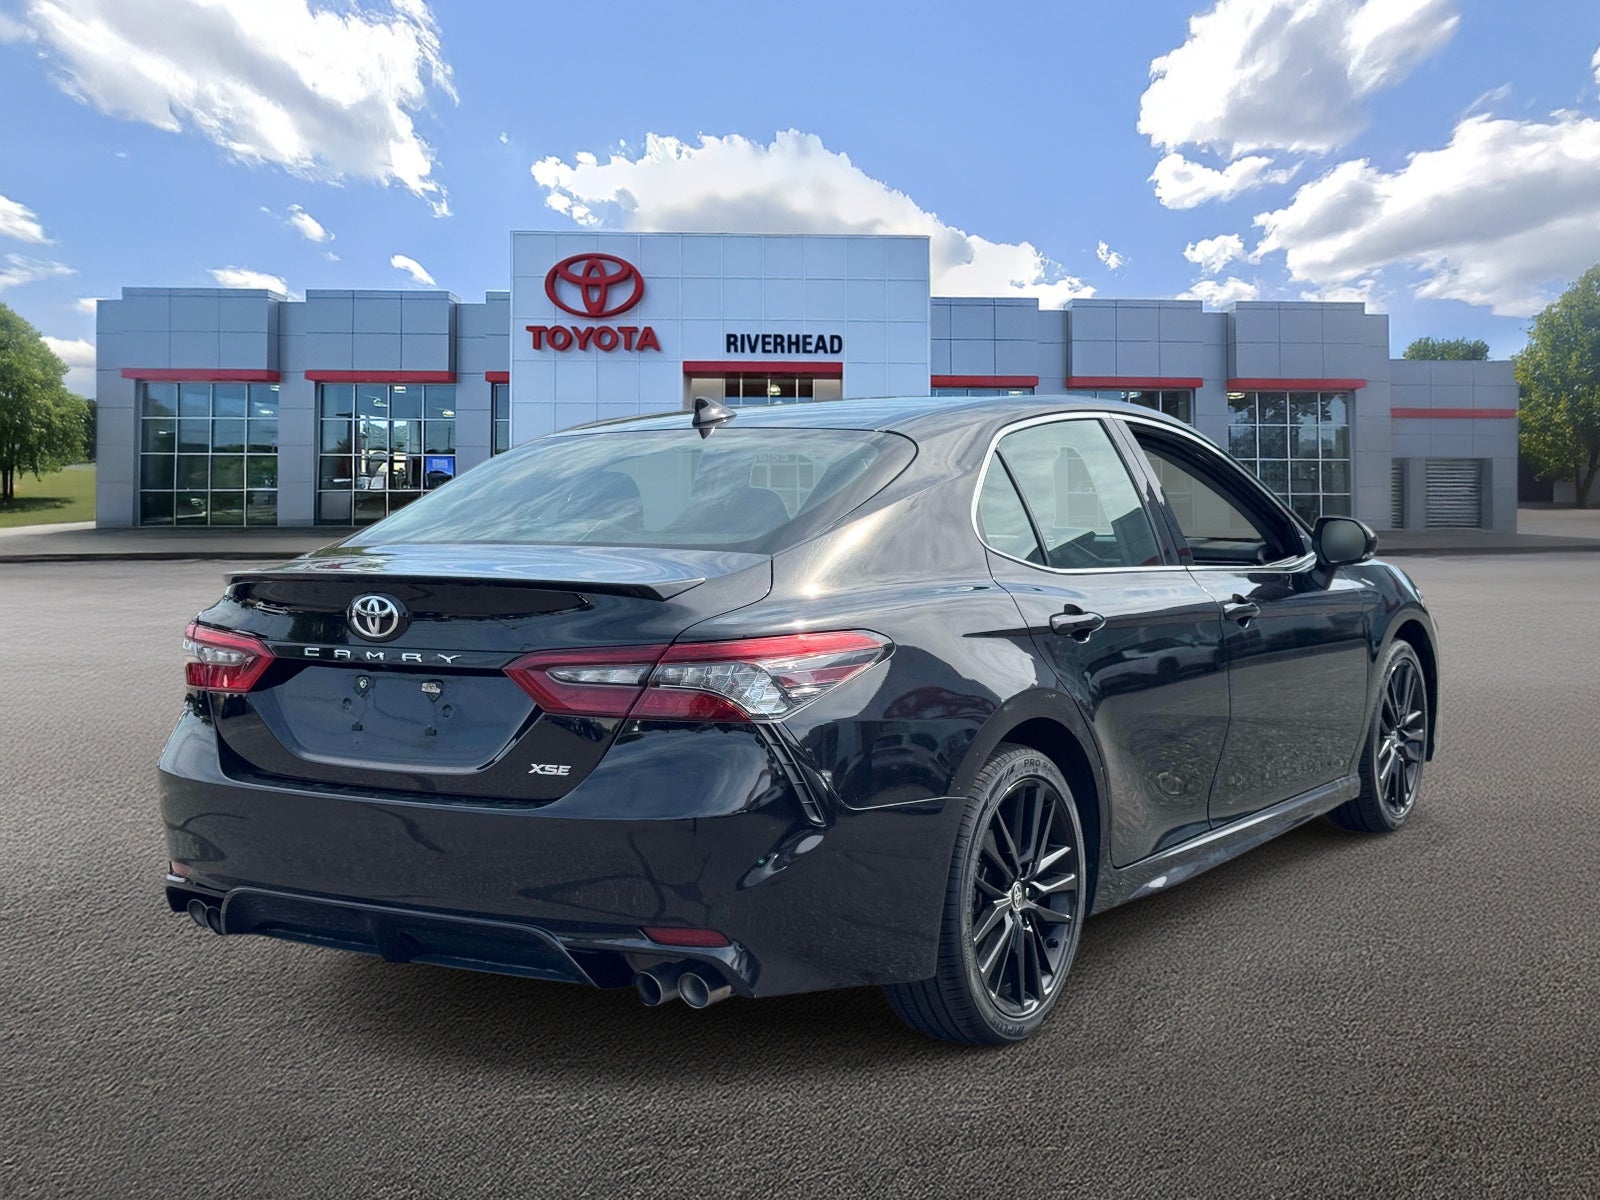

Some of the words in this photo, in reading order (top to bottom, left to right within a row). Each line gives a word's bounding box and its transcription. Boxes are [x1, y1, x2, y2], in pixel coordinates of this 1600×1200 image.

[525, 325, 661, 352] TOYOTA
[725, 333, 843, 354] RIVERHEAD
[303, 648, 462, 664] CAMRY
[528, 763, 572, 776] XSE
[1023, 758, 1041, 768] PRO
